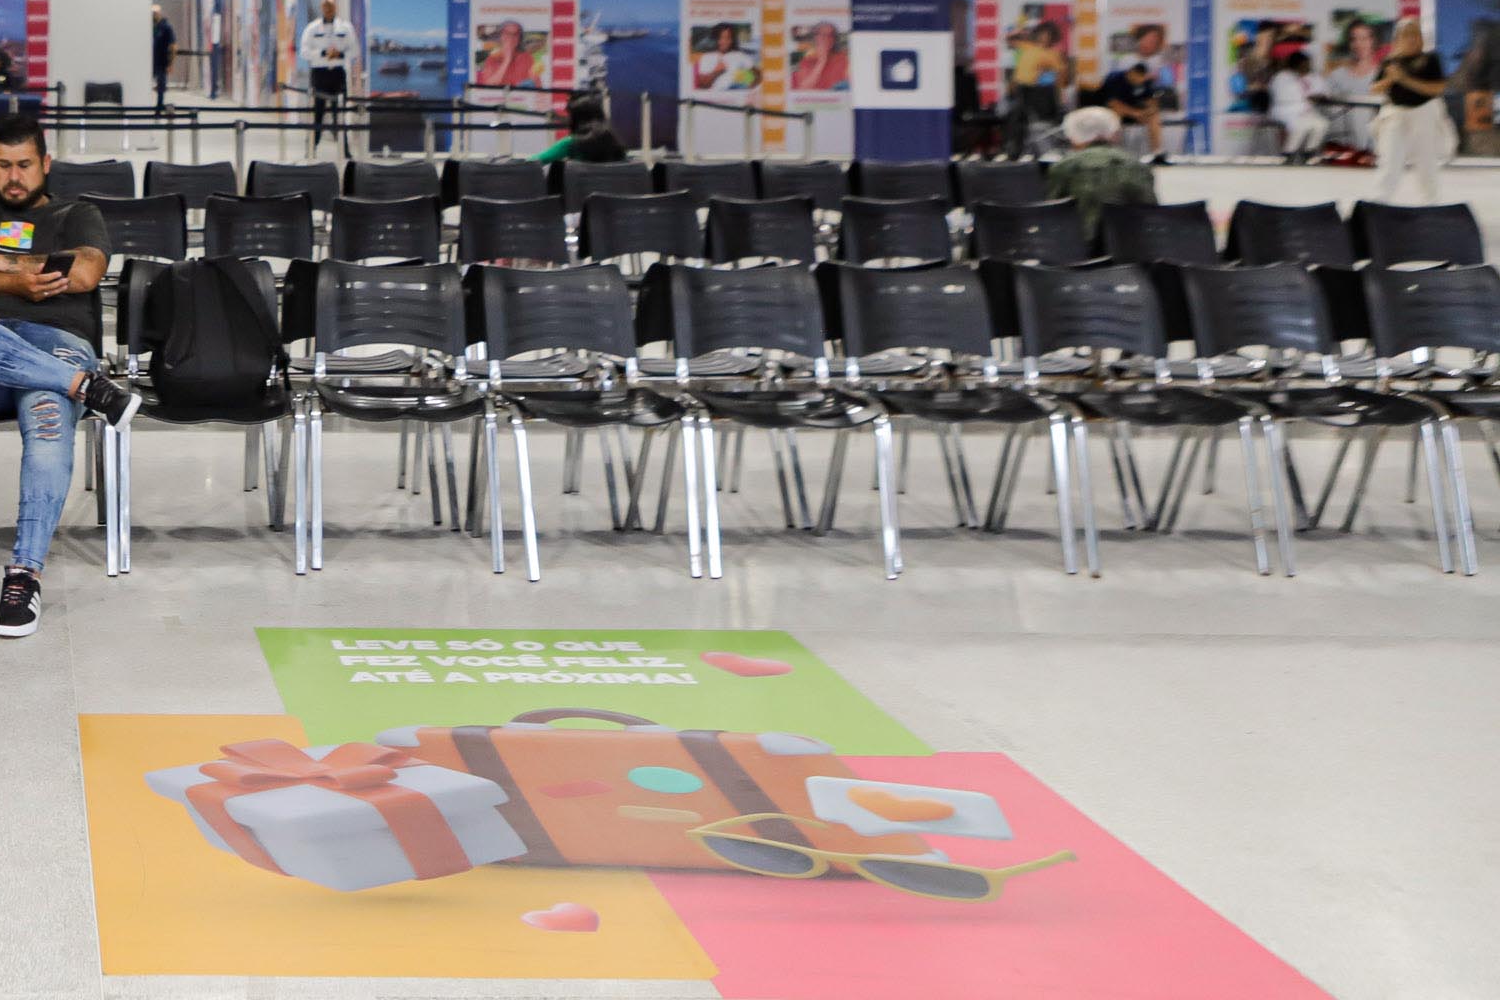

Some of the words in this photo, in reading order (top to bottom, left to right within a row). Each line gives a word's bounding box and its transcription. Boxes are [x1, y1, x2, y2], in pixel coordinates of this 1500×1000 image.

[331, 639, 441, 651] LEVE
[446, 638, 504, 651] SÓ
[512, 641, 545, 652] O
[553, 641, 645, 652] QUE
[339, 655, 422, 667] FEZ
[426, 653, 549, 668] VOCÊ
[350, 669, 437, 684] ATÉ
[443, 671, 479, 684] A
[482, 670, 699, 685] PRÓXIMA!
